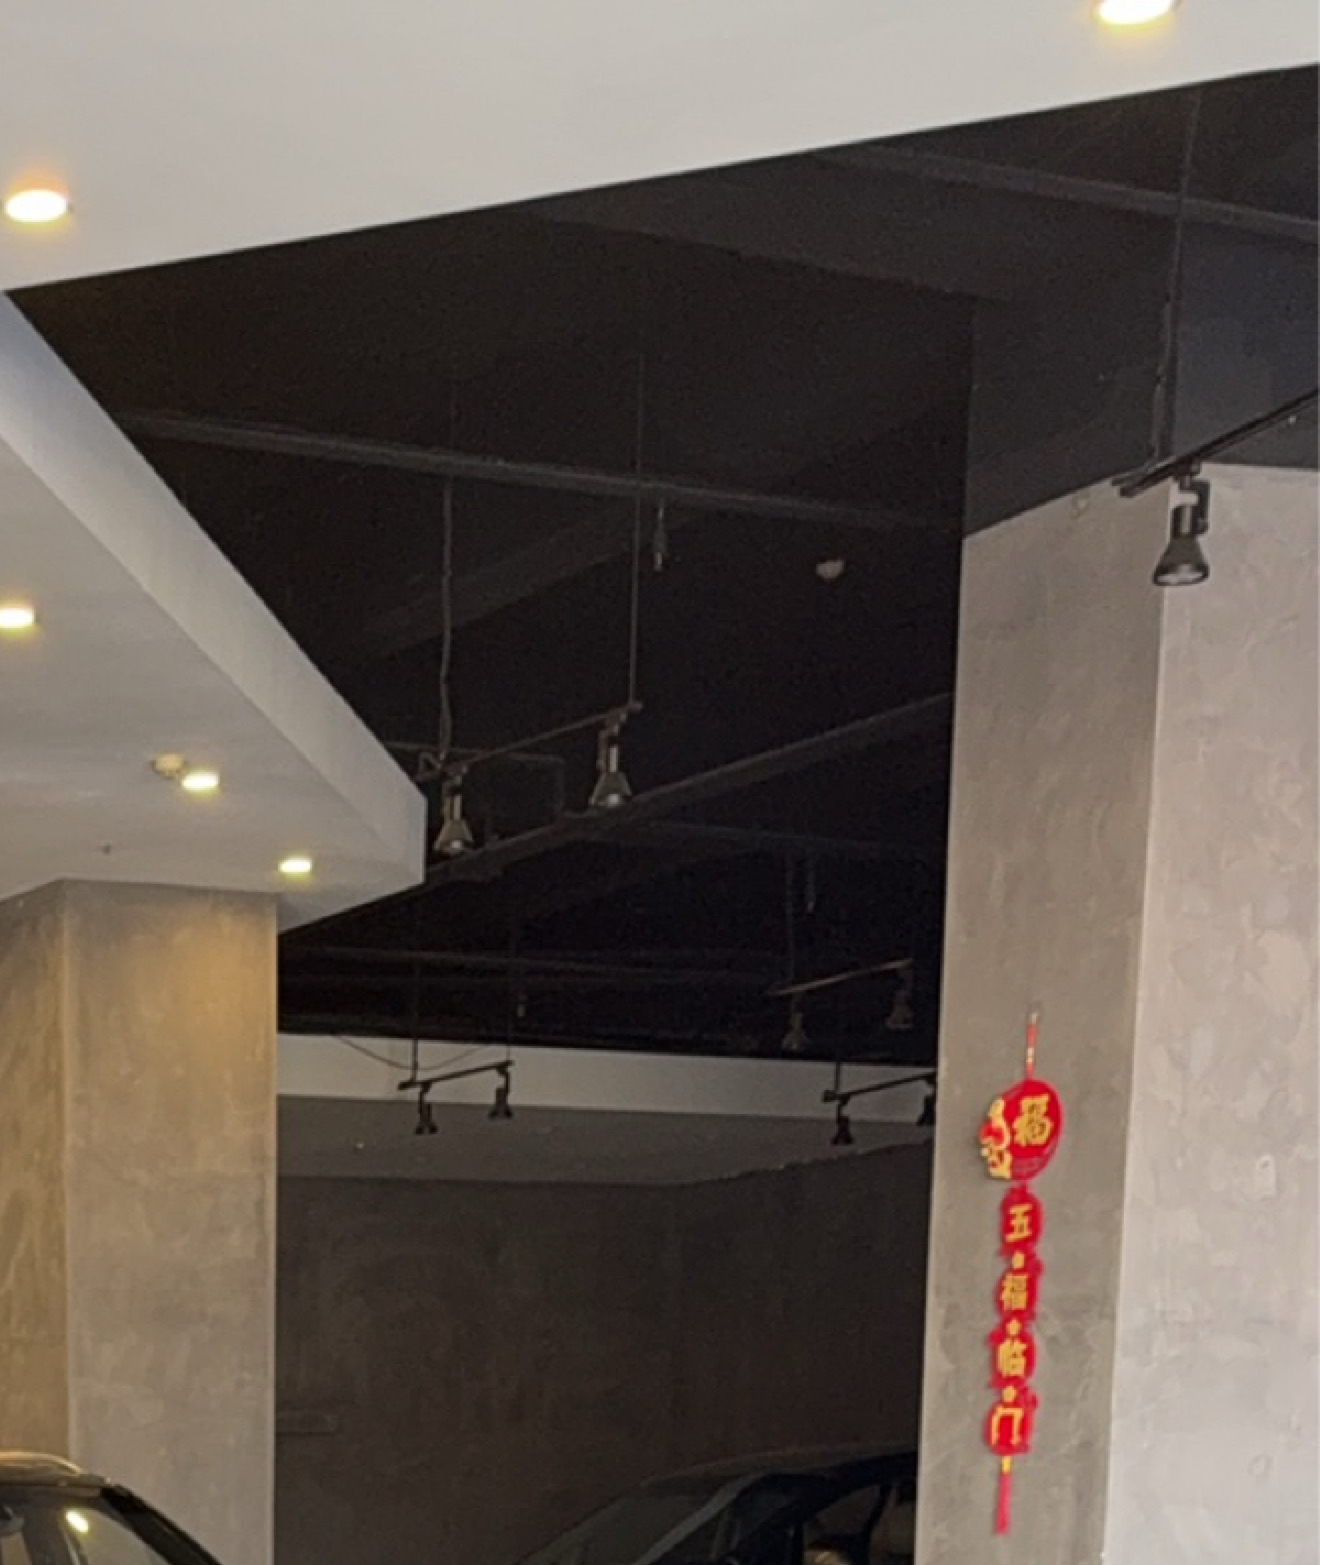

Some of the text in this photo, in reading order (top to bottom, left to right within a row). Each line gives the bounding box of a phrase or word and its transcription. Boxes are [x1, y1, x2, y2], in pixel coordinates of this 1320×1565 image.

[1013, 1094, 1053, 1147] 福
[990, 1203, 1034, 1446] 五福临门
